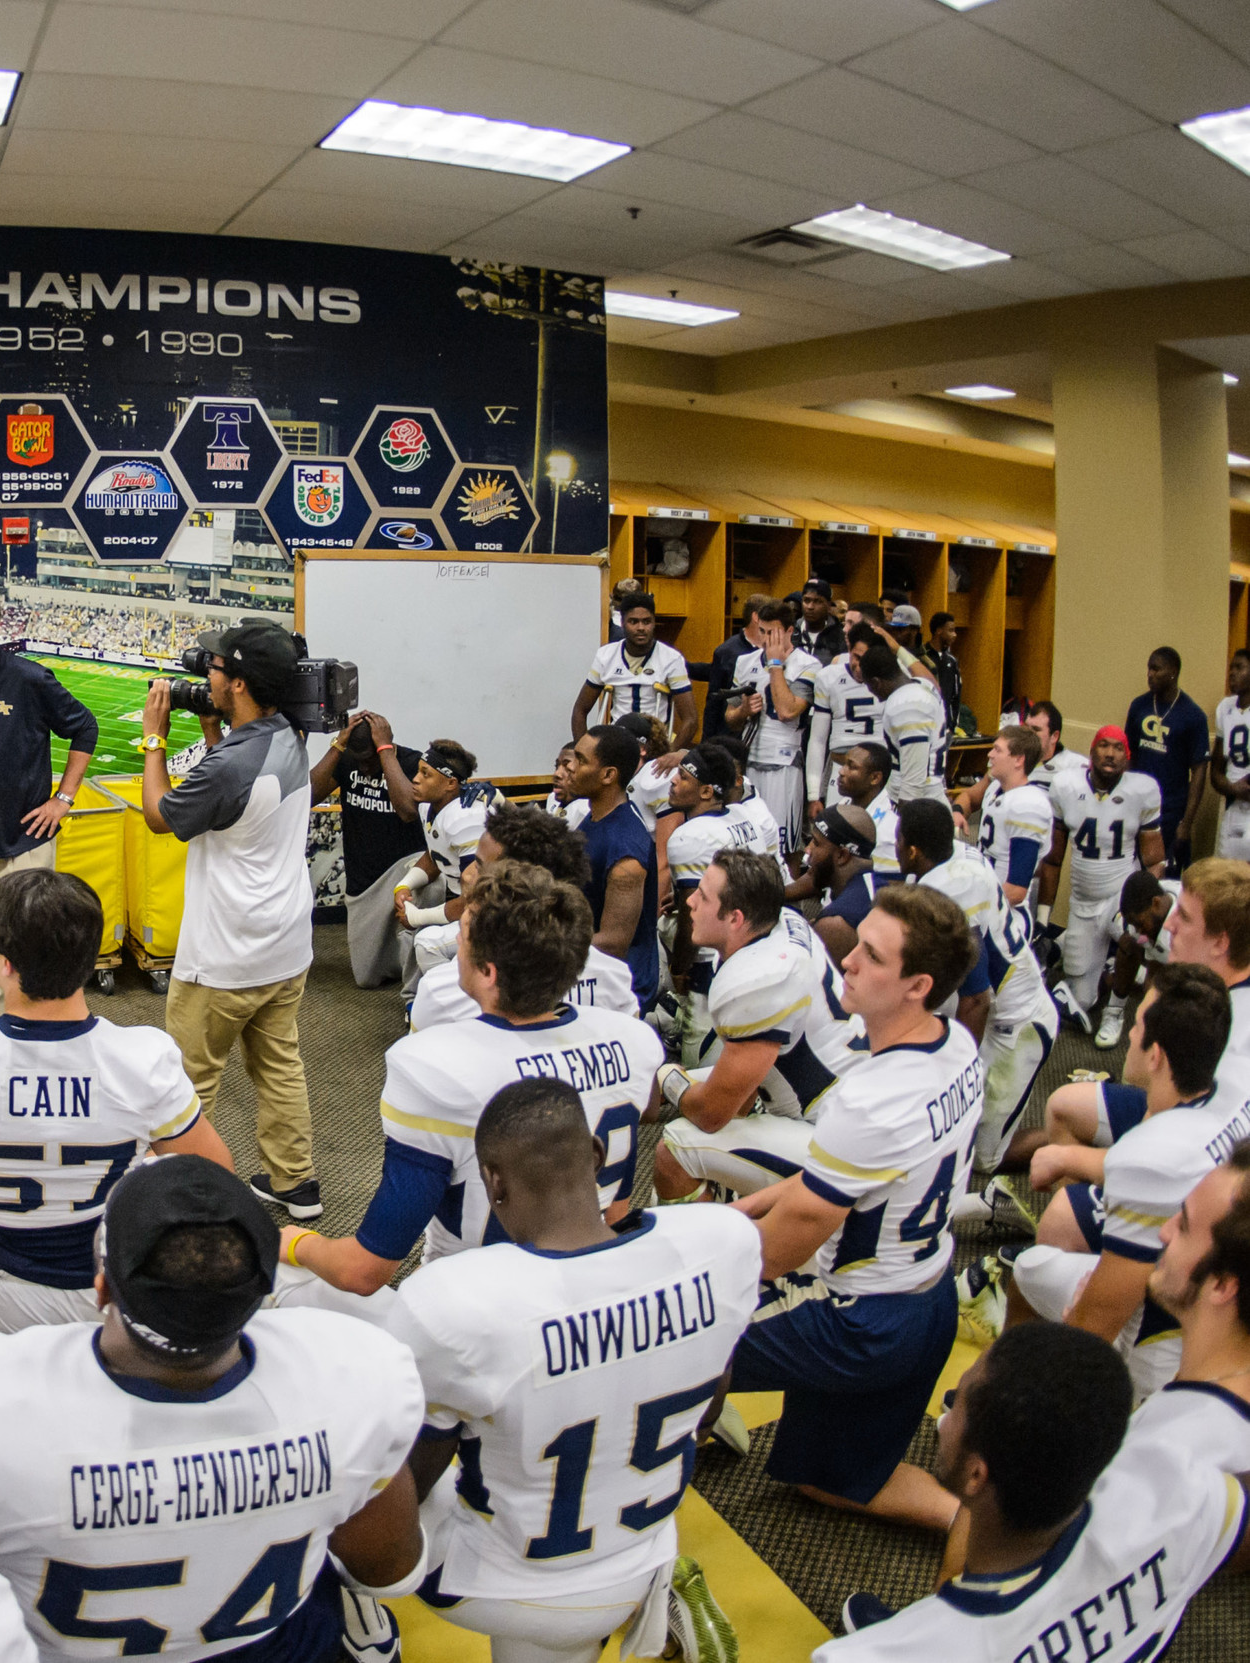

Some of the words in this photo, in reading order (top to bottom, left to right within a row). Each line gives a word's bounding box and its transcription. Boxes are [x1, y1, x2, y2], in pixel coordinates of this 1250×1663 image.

[135, 329, 244, 357] 1990
[9, 421, 51, 437] GATOR
[206, 452, 250, 471] LIBERTY
[111, 472, 157, 488] Roady's
[211, 480, 244, 489] 1972
[297, 468, 340, 484] FedEx
[2, 493, 19, 501] 07
[391, 486, 421, 494] 1929
[85, 493, 178, 510] HUMANITARIAN
[475, 542, 503, 551] 2002
[439, 564, 488, 578] OFFENSE
[845, 697, 875, 735] 5
[346, 791, 396, 813] DEMOPOLI
[1074, 816, 1126, 861] 41
[8, 1075, 92, 1119] CAIN
[541, 1270, 717, 1378] ONWUALU
[524, 1373, 724, 1563] 15
[69, 1429, 333, 1531] CERGE-HENDERSON
[36, 1528, 315, 1657] 54
